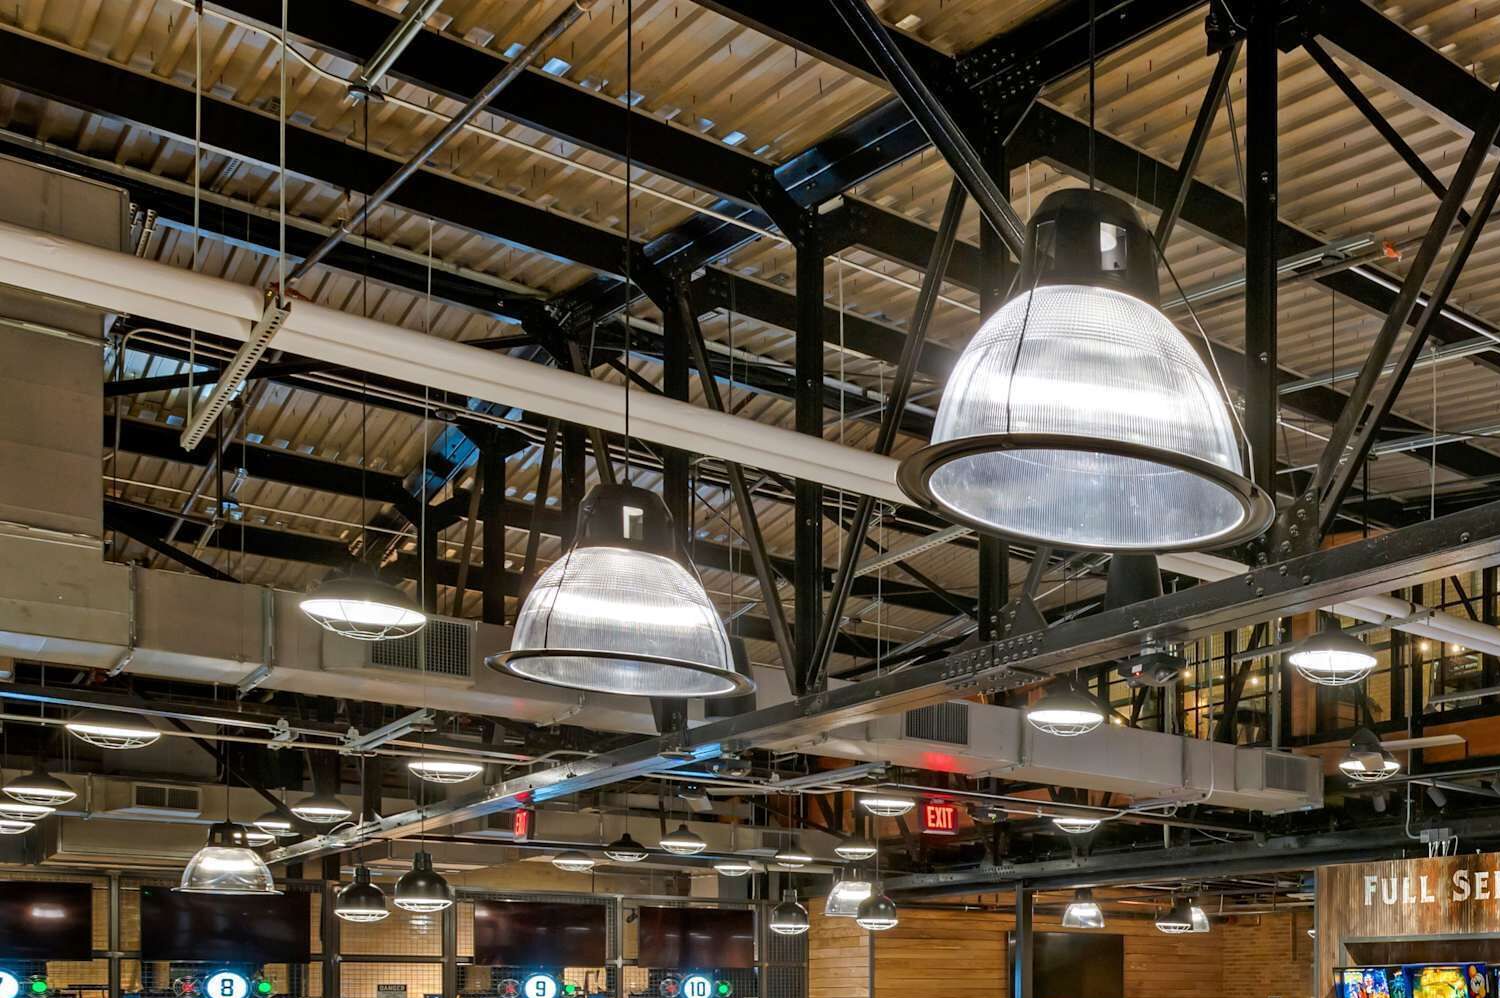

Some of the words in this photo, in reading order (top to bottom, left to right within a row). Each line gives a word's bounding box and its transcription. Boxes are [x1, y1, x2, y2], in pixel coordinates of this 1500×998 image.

[926, 805, 954, 829] EXIT
[1364, 875, 1435, 906] FULL
[221, 979, 233, 996] 8
[536, 981, 546, 996] 9
[691, 981, 706, 997] 10
